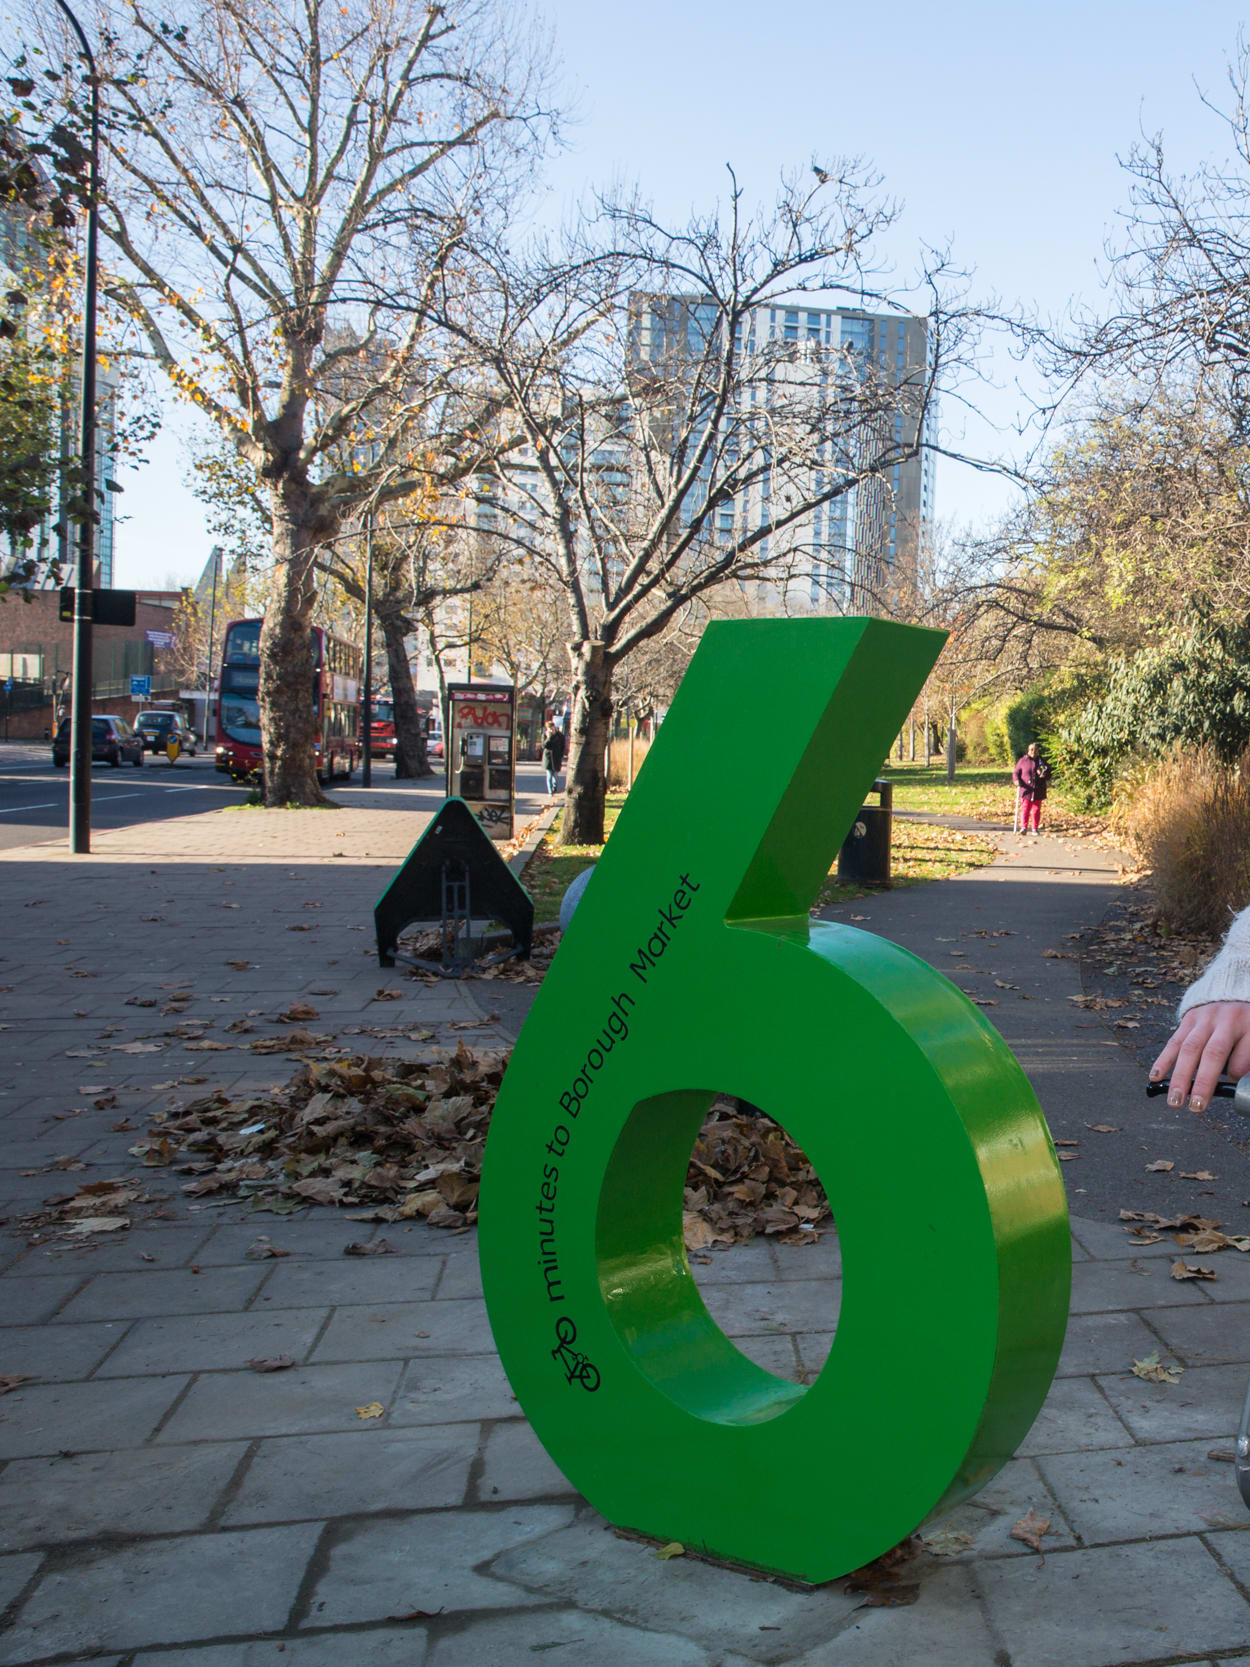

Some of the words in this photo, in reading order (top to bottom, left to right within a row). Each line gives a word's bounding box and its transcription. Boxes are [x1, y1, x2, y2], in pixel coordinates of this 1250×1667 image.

[629, 871, 700, 985] Market
[477, 616, 1071, 1583] 6
[558, 992, 636, 1119] Borough
[545, 1124, 570, 1158] to
[535, 1163, 565, 1303] minutes
